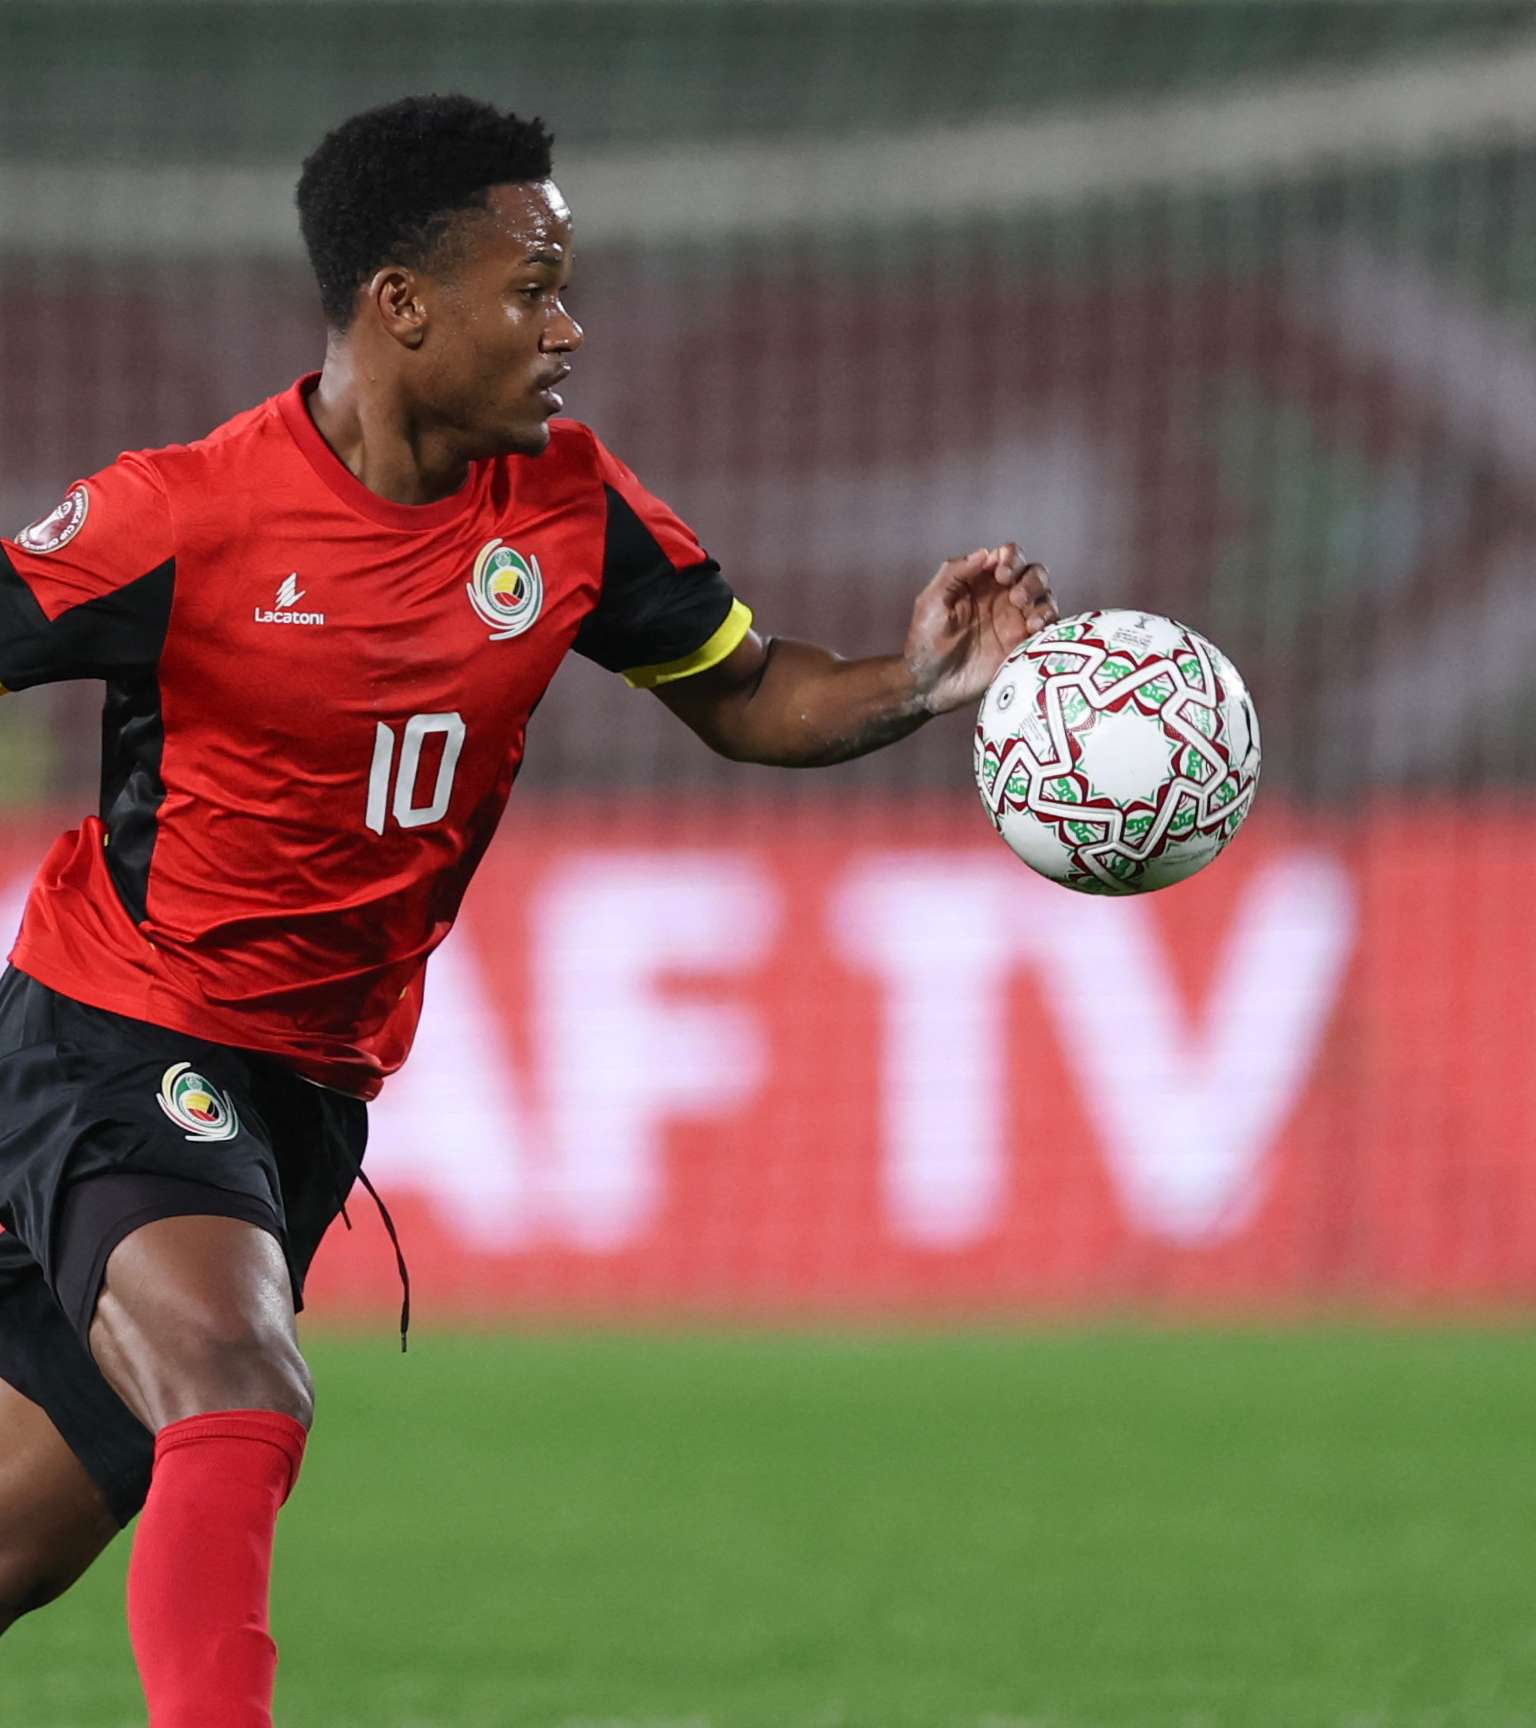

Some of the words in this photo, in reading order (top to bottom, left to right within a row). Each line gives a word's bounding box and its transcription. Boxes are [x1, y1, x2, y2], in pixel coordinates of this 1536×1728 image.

[255, 607, 325, 625] Lacatoni
[365, 712, 466, 836] 10
[826, 850, 1356, 1250] TV
